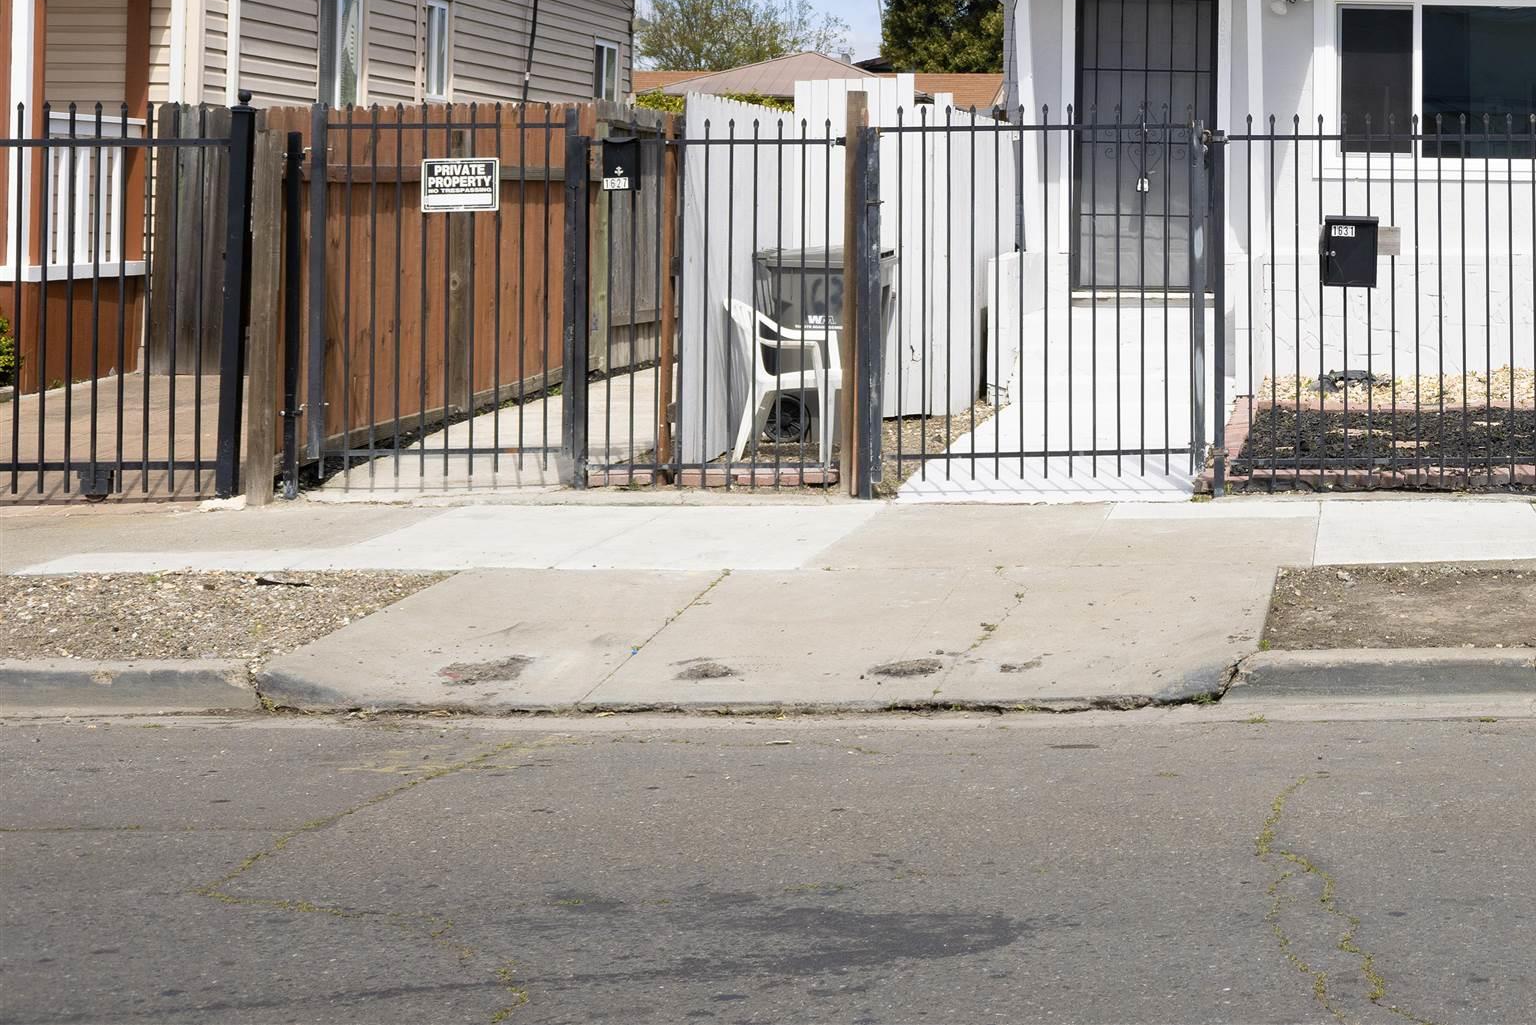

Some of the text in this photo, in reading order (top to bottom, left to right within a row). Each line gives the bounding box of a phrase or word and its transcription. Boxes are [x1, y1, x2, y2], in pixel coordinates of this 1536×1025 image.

[434, 164, 485, 176] PRIVATE
[428, 176, 492, 188] PROPERTY
[605, 178, 627, 188] 1627
[1333, 226, 1354, 236] 1631
